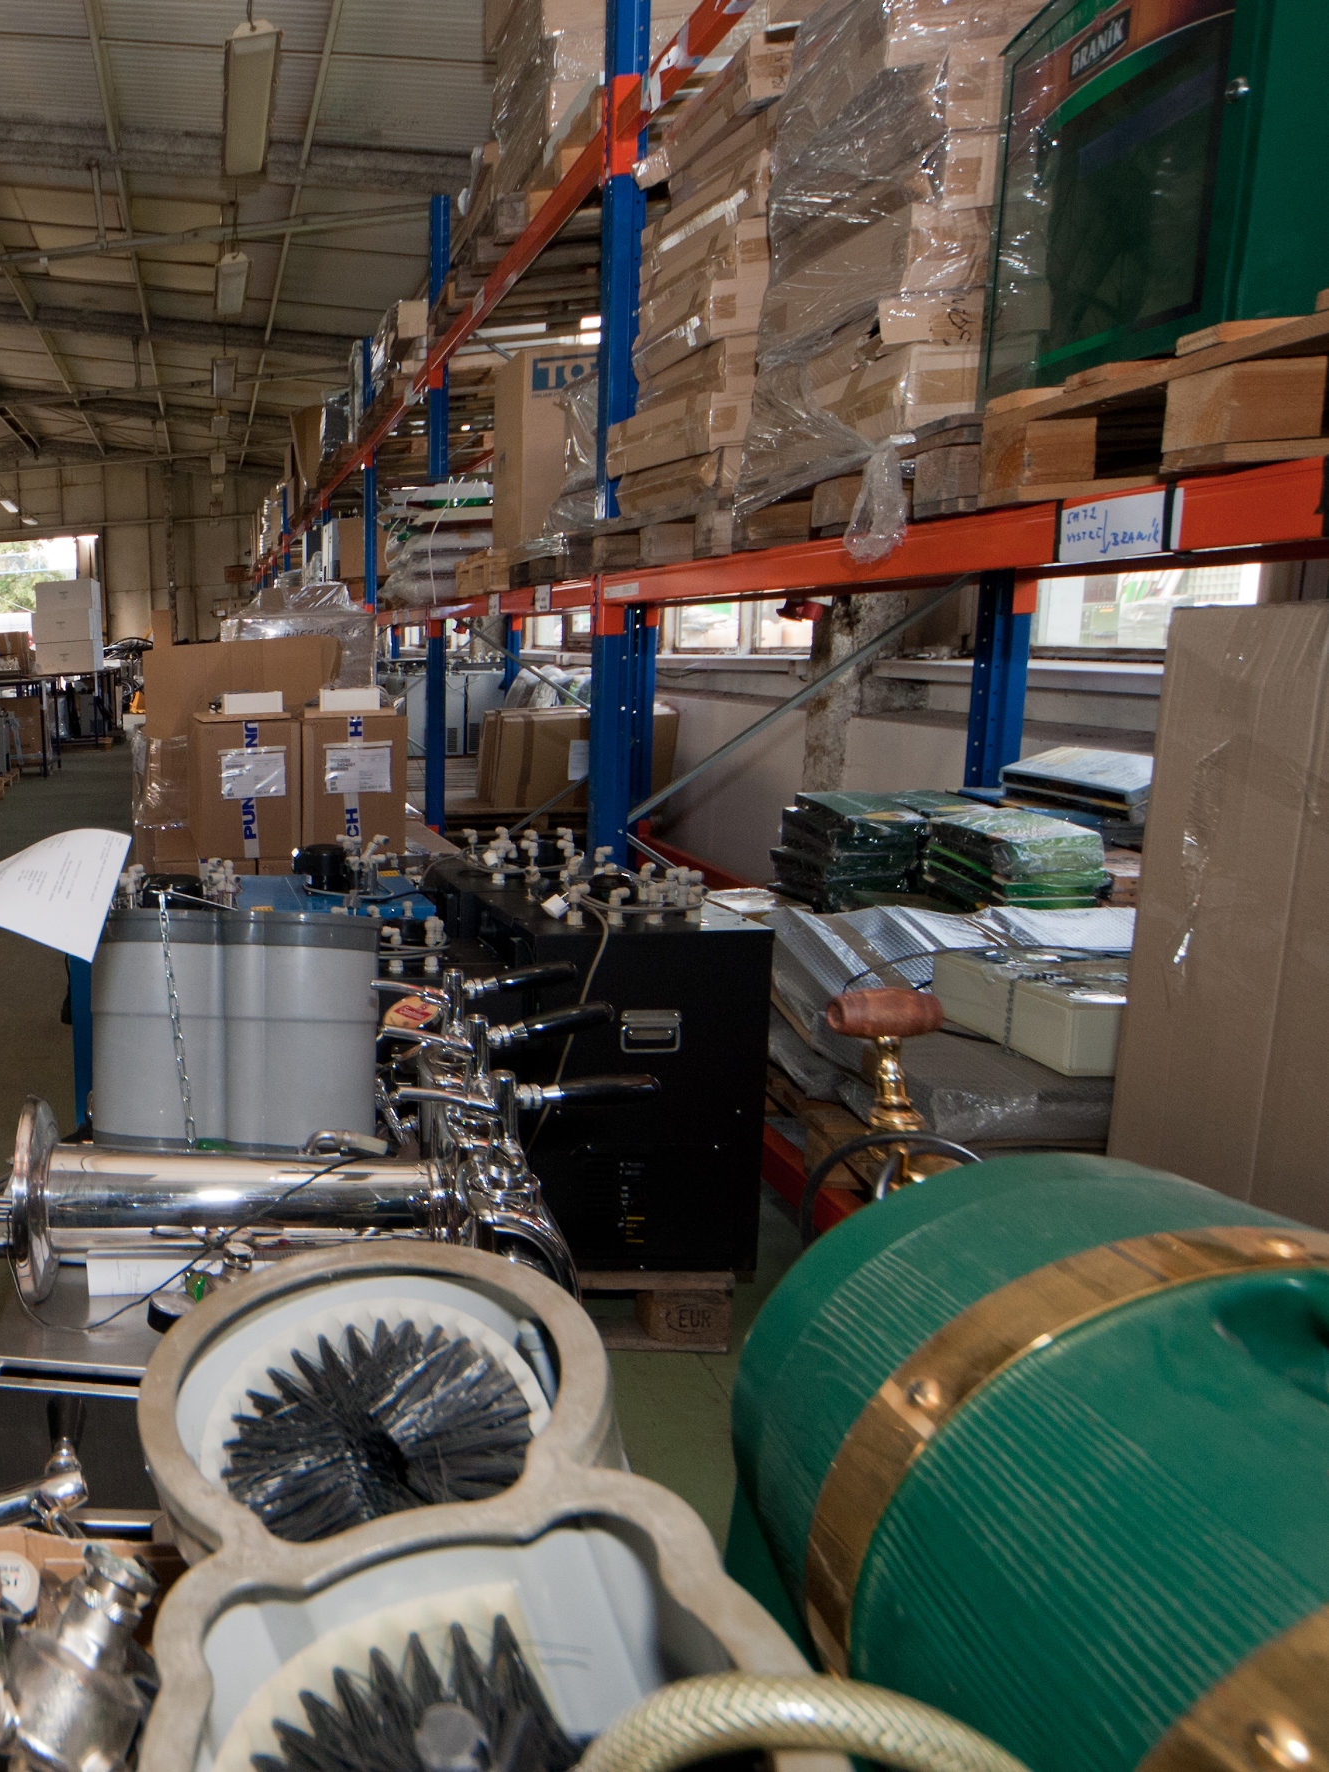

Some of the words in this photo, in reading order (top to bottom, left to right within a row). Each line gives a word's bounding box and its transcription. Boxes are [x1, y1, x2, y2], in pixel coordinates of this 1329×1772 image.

[1072, 17, 1124, 76] BRANÍK
[241, 797, 257, 840] PUN
[345, 807, 360, 837] CH
[678, 1308, 712, 1328] EUR
